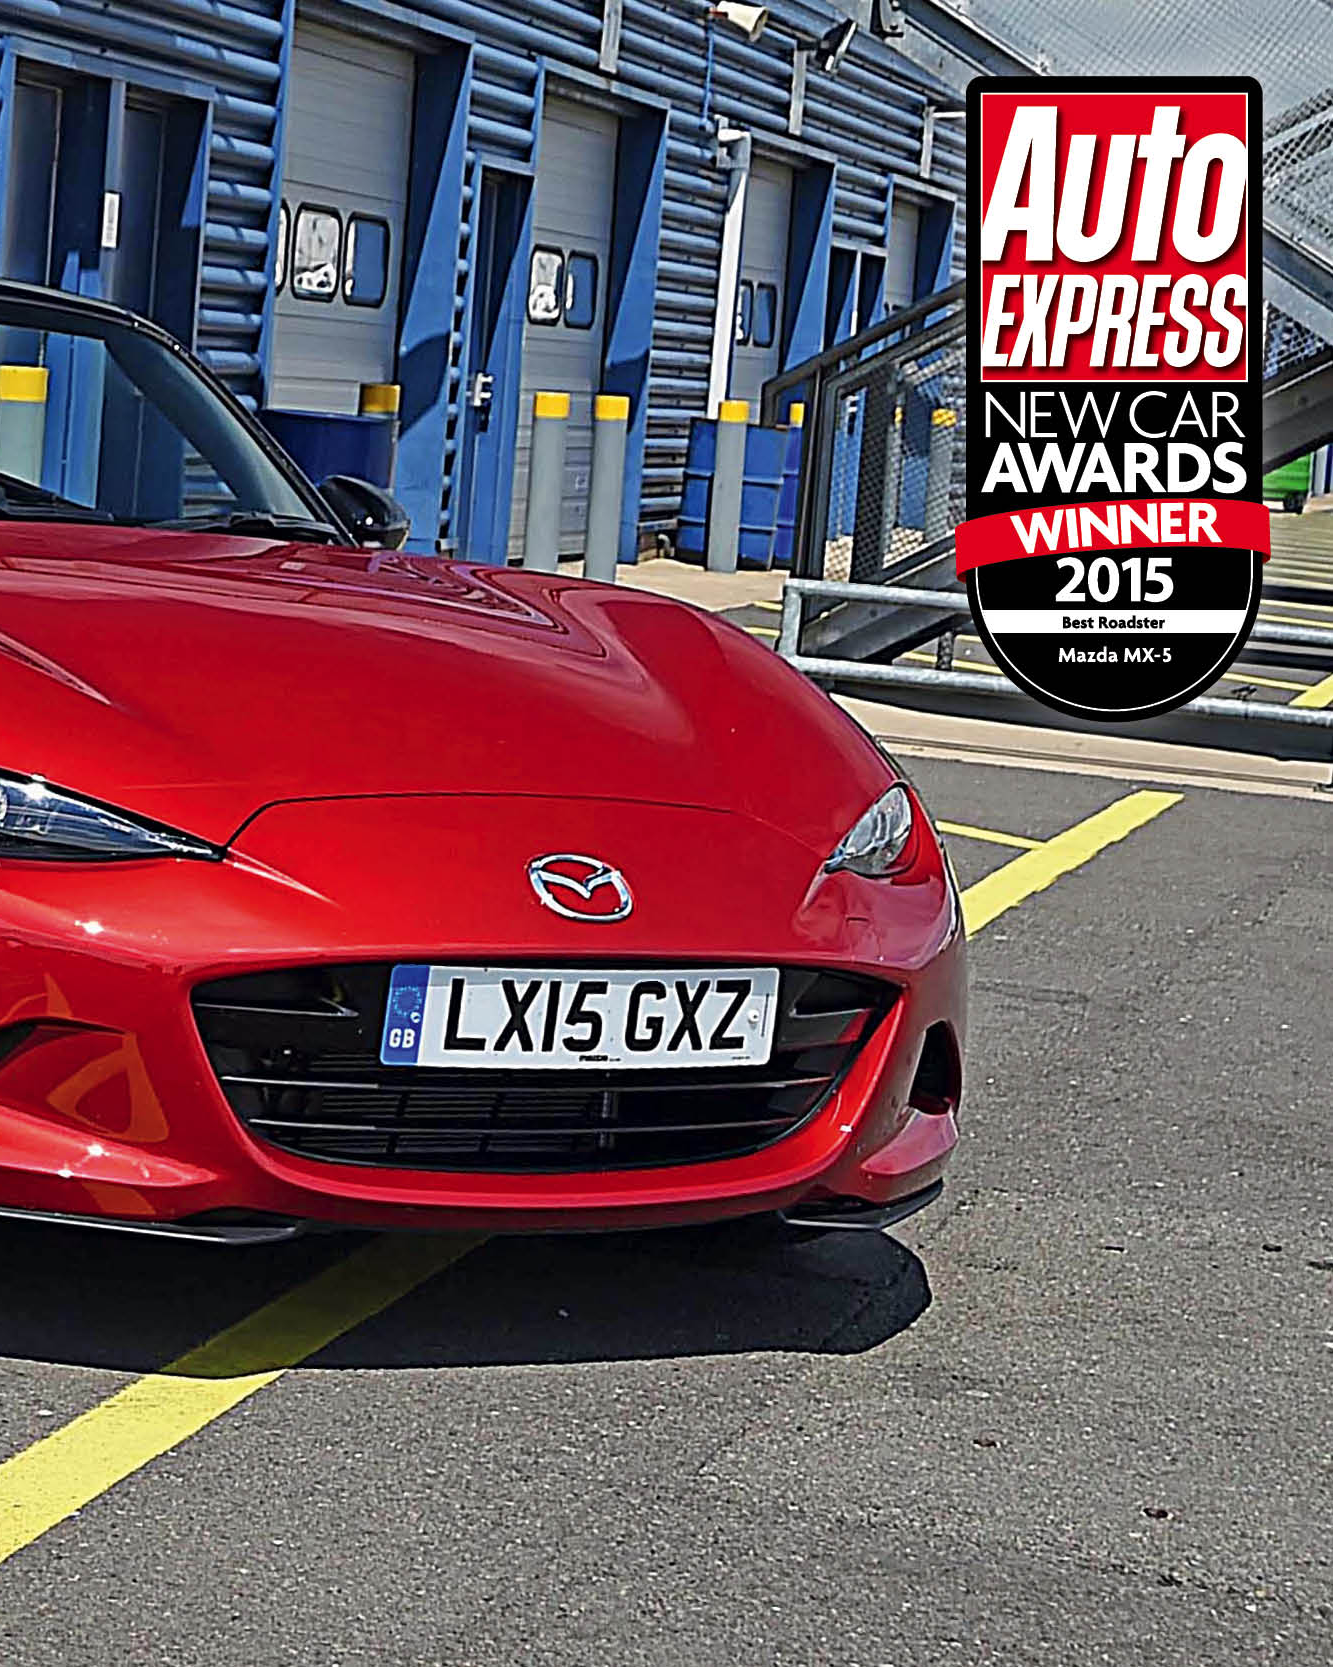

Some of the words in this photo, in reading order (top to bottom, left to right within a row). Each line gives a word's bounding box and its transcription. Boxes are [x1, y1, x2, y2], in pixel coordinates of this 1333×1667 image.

[388, 1028, 416, 1049] GB
[443, 978, 609, 1053] LX15
[624, 979, 752, 1053] GXZ
